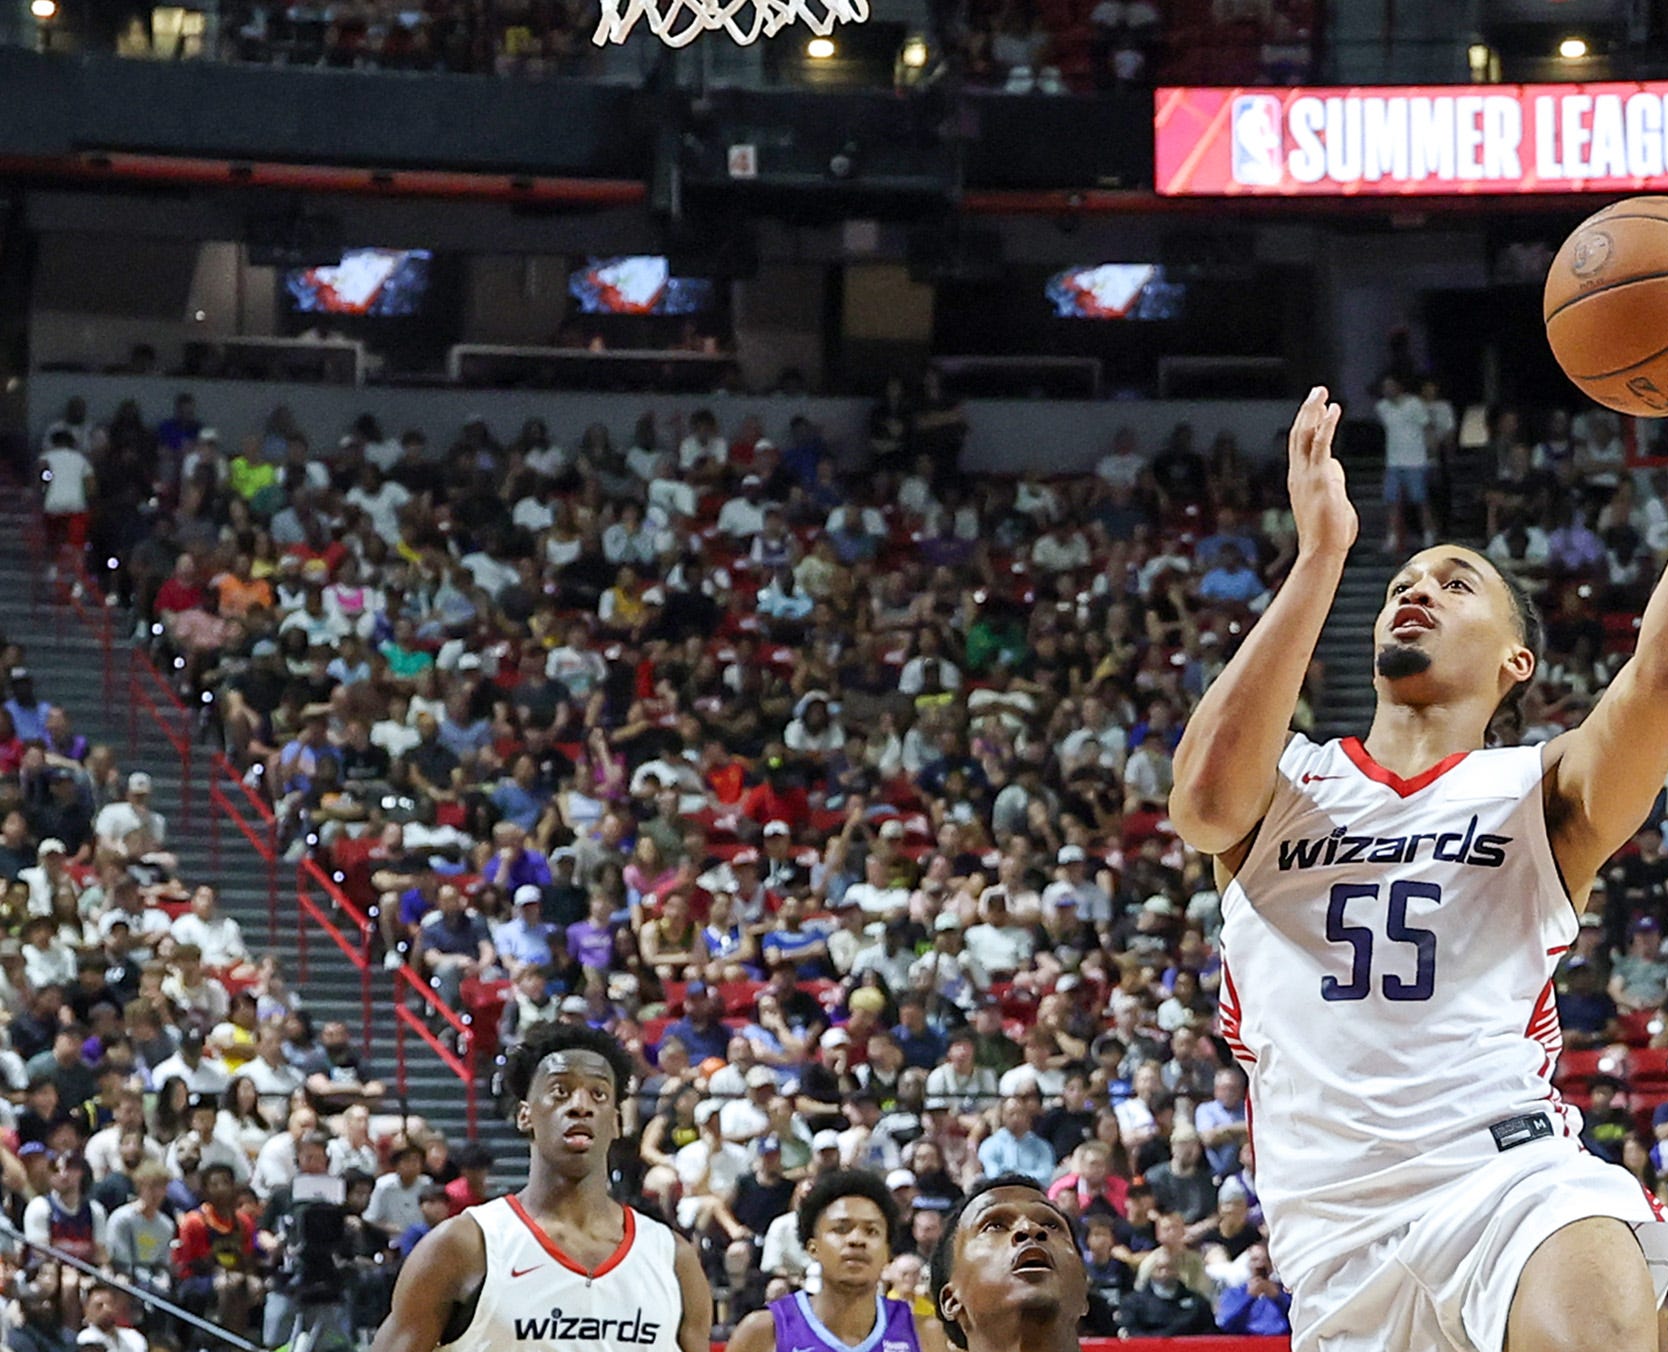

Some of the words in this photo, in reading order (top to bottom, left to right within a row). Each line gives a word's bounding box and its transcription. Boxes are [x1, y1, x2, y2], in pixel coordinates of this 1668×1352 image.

[1287, 94, 1522, 182] SUMMER
[1278, 814, 1514, 871] wizards
[1321, 880, 1442, 1002] 55
[1533, 1118, 1547, 1130] M
[514, 1306, 661, 1345] wizards
